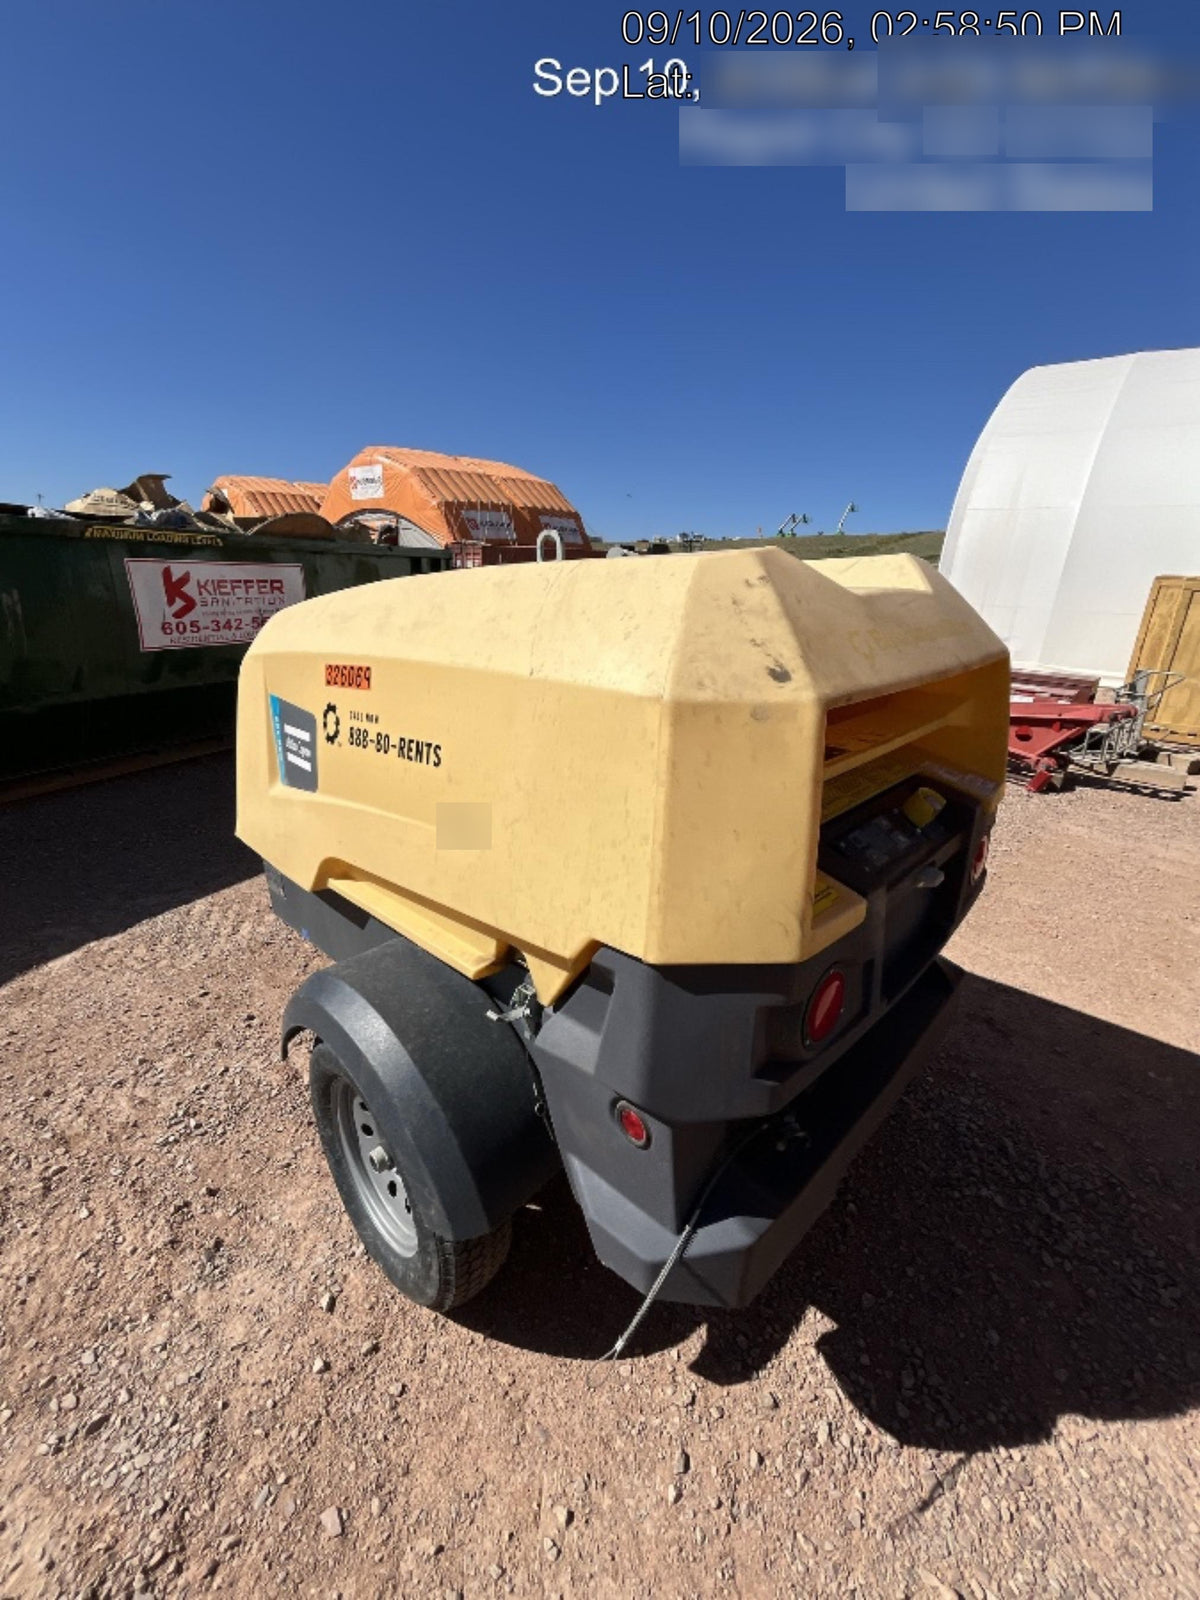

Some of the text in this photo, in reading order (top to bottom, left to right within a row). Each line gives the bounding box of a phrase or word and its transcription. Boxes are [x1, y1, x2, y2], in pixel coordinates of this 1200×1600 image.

[197, 579, 285, 596] KIEFFER
[326, 664, 371, 689] 326069
[348, 726, 442, 768] 888-80-RENTS
